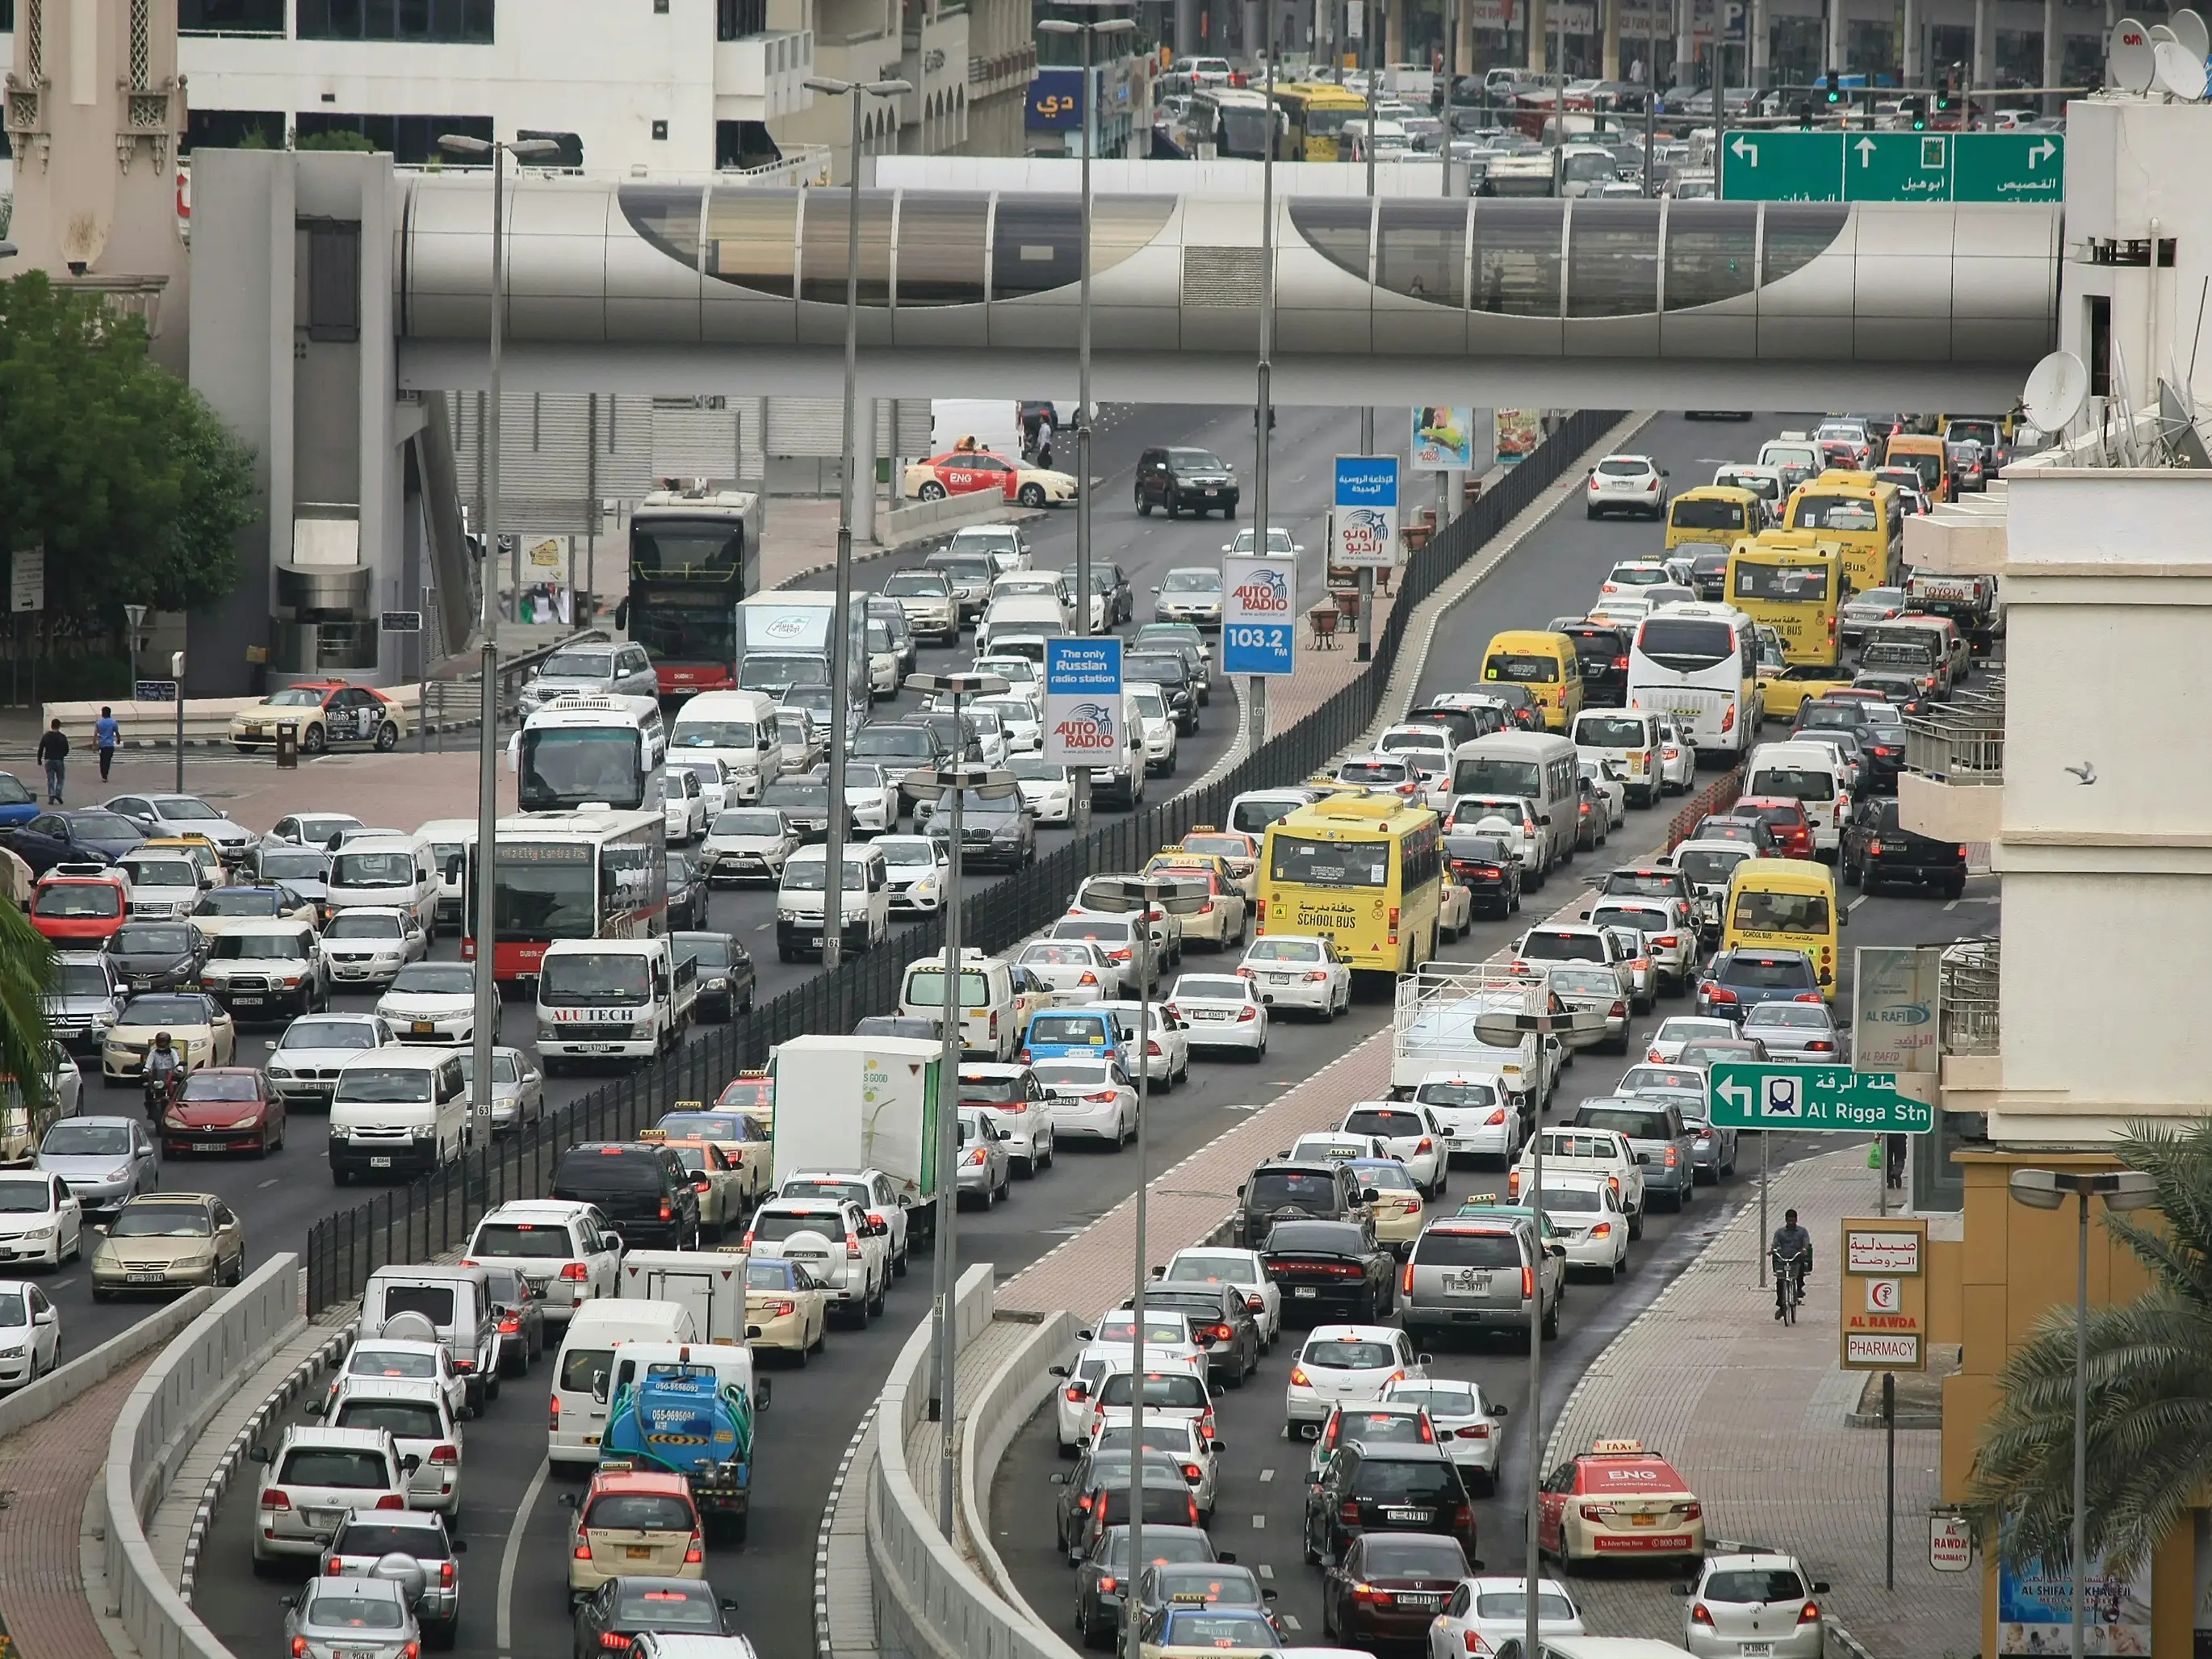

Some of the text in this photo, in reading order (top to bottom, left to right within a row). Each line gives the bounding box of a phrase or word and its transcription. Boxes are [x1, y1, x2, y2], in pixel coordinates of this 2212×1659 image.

[1901, 177, 1945, 191] أبوهيل
[1996, 178, 2055, 192] القصيص
[949, 472, 972, 483] ENG
[1352, 484, 1380, 494] الوحيدة
[1346, 541, 1382, 555] راديو
[1845, 562, 1866, 572] Bus
[1231, 586, 1271, 598] AUTO
[1924, 586, 1964, 597] TOYOTA
[1242, 598, 1287, 610] RADIO
[1757, 614, 1802, 623] حافلة مدرسية
[1787, 626, 1802, 635] BUS
[1229, 628, 1283, 647] 103.2
[1061, 649, 1105, 660] The only
[1274, 648, 1288, 656] FM
[1056, 660, 1107, 671] Russian
[1051, 675, 1115, 683] radio station
[1054, 722, 1096, 735] AUTO
[1066, 735, 1113, 748] RADIO
[1081, 800, 1089, 808] 61
[1299, 901, 1355, 914] حافلة مدرسية
[1298, 913, 1356, 928] SCHOOL BUS
[829, 939, 839, 947] 62
[1865, 1006, 1930, 1025] AL RAFID
[1894, 1034, 1933, 1049] الرافد
[1861, 1051, 1900, 1062] AL RAFID
[869, 1074, 888, 1083] GOOD
[1816, 1072, 1896, 1094] طة الرقة
[479, 1106, 488, 1116] 63
[1807, 1102, 1927, 1124] Al Rigga Stn
[1850, 1237, 1917, 1255] صيدلية
[1851, 1255, 1916, 1270] الروضة
[935, 1306, 942, 1315] 85
[1850, 1317, 1917, 1330] AL RAWDA
[1850, 1341, 1916, 1357] PHARMACY
[1607, 1443, 1632, 1451] TAXI
[1608, 1471, 1657, 1480] ENG
[1945, 1525, 1957, 1535] AL
[1934, 1538, 1967, 1549] RAWDA
[2021, 1586, 2033, 1596] AL
[2037, 1586, 2066, 1596] SHIFA
